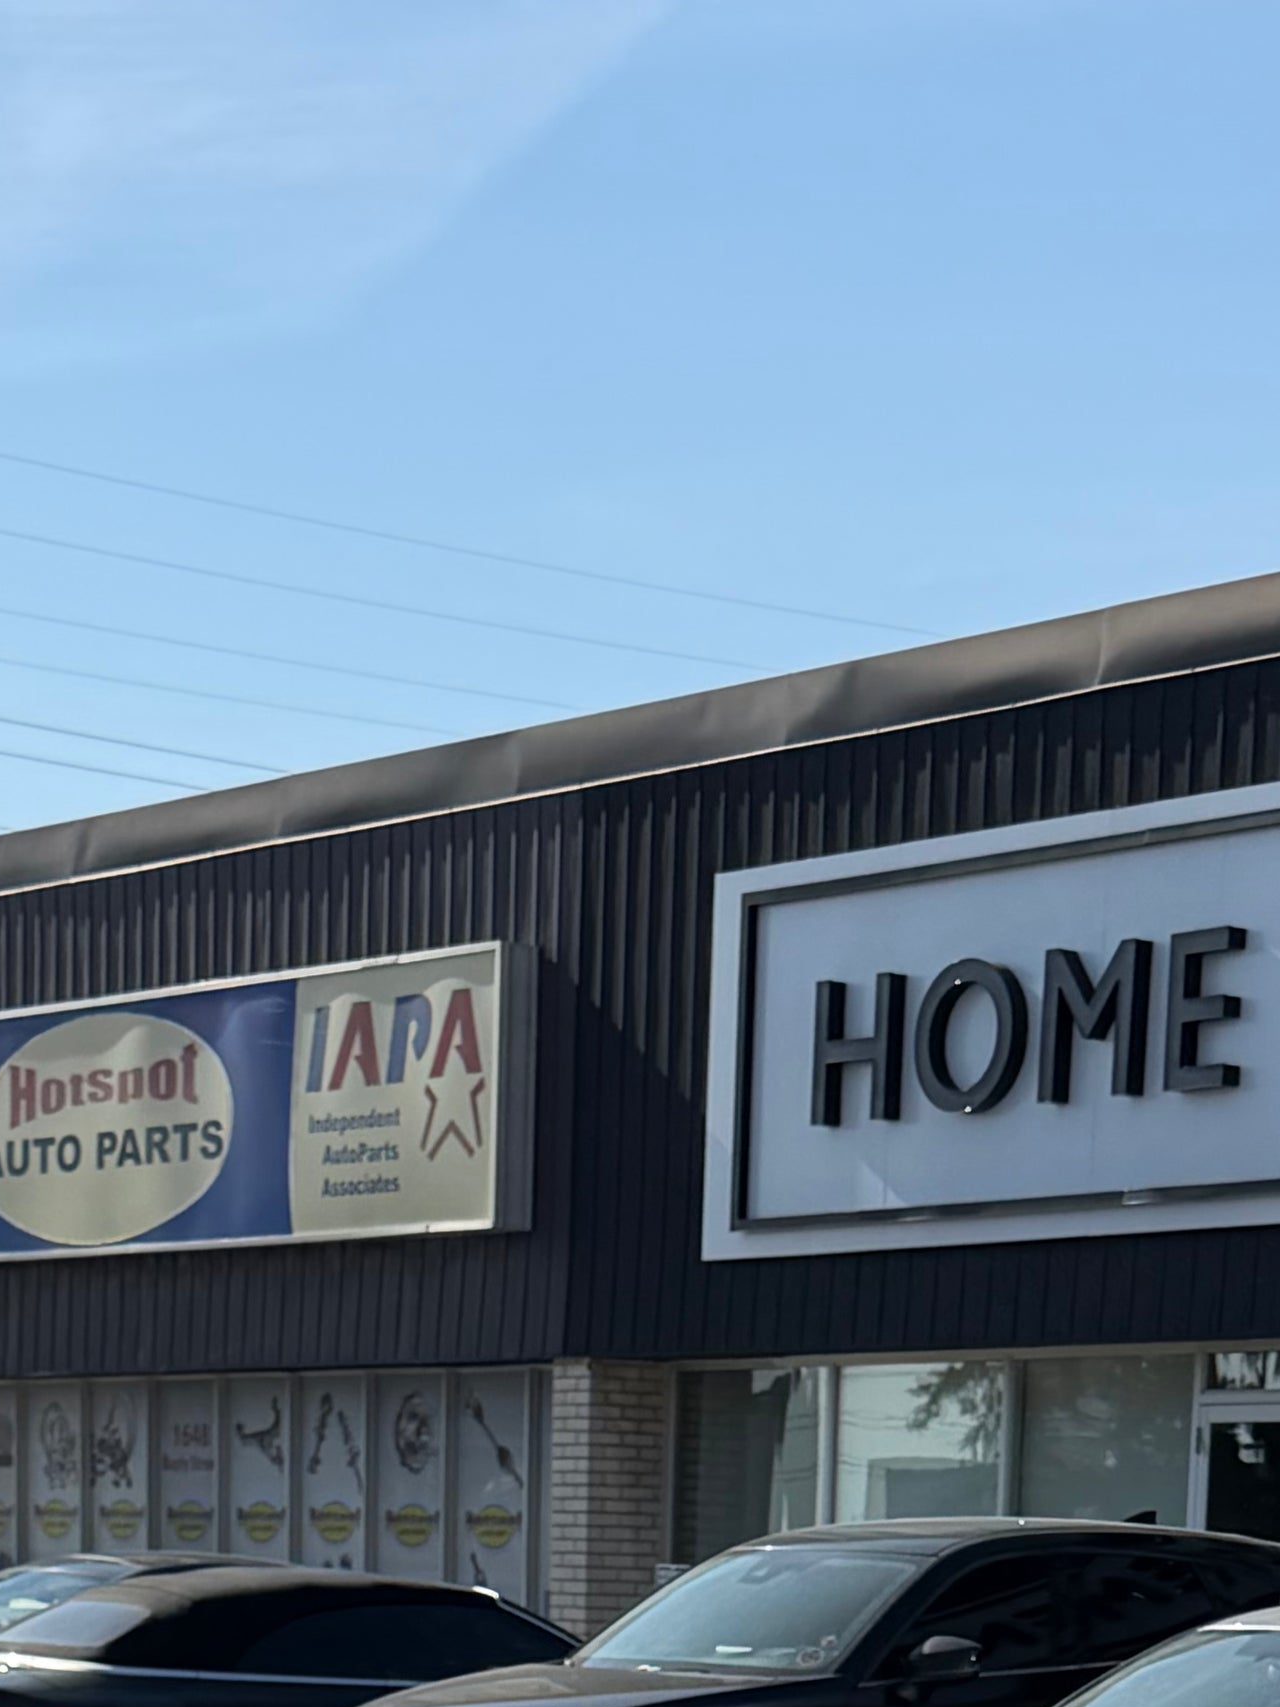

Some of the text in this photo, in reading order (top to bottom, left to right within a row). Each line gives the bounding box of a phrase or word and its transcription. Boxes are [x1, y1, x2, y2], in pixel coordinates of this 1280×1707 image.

[306, 988, 483, 1093] IAPA
[811, 926, 1247, 1126] HOME
[96, 1120, 224, 1170] PARTS
[308, 1108, 400, 1135] Independent
[321, 1174, 400, 1198] Associates
